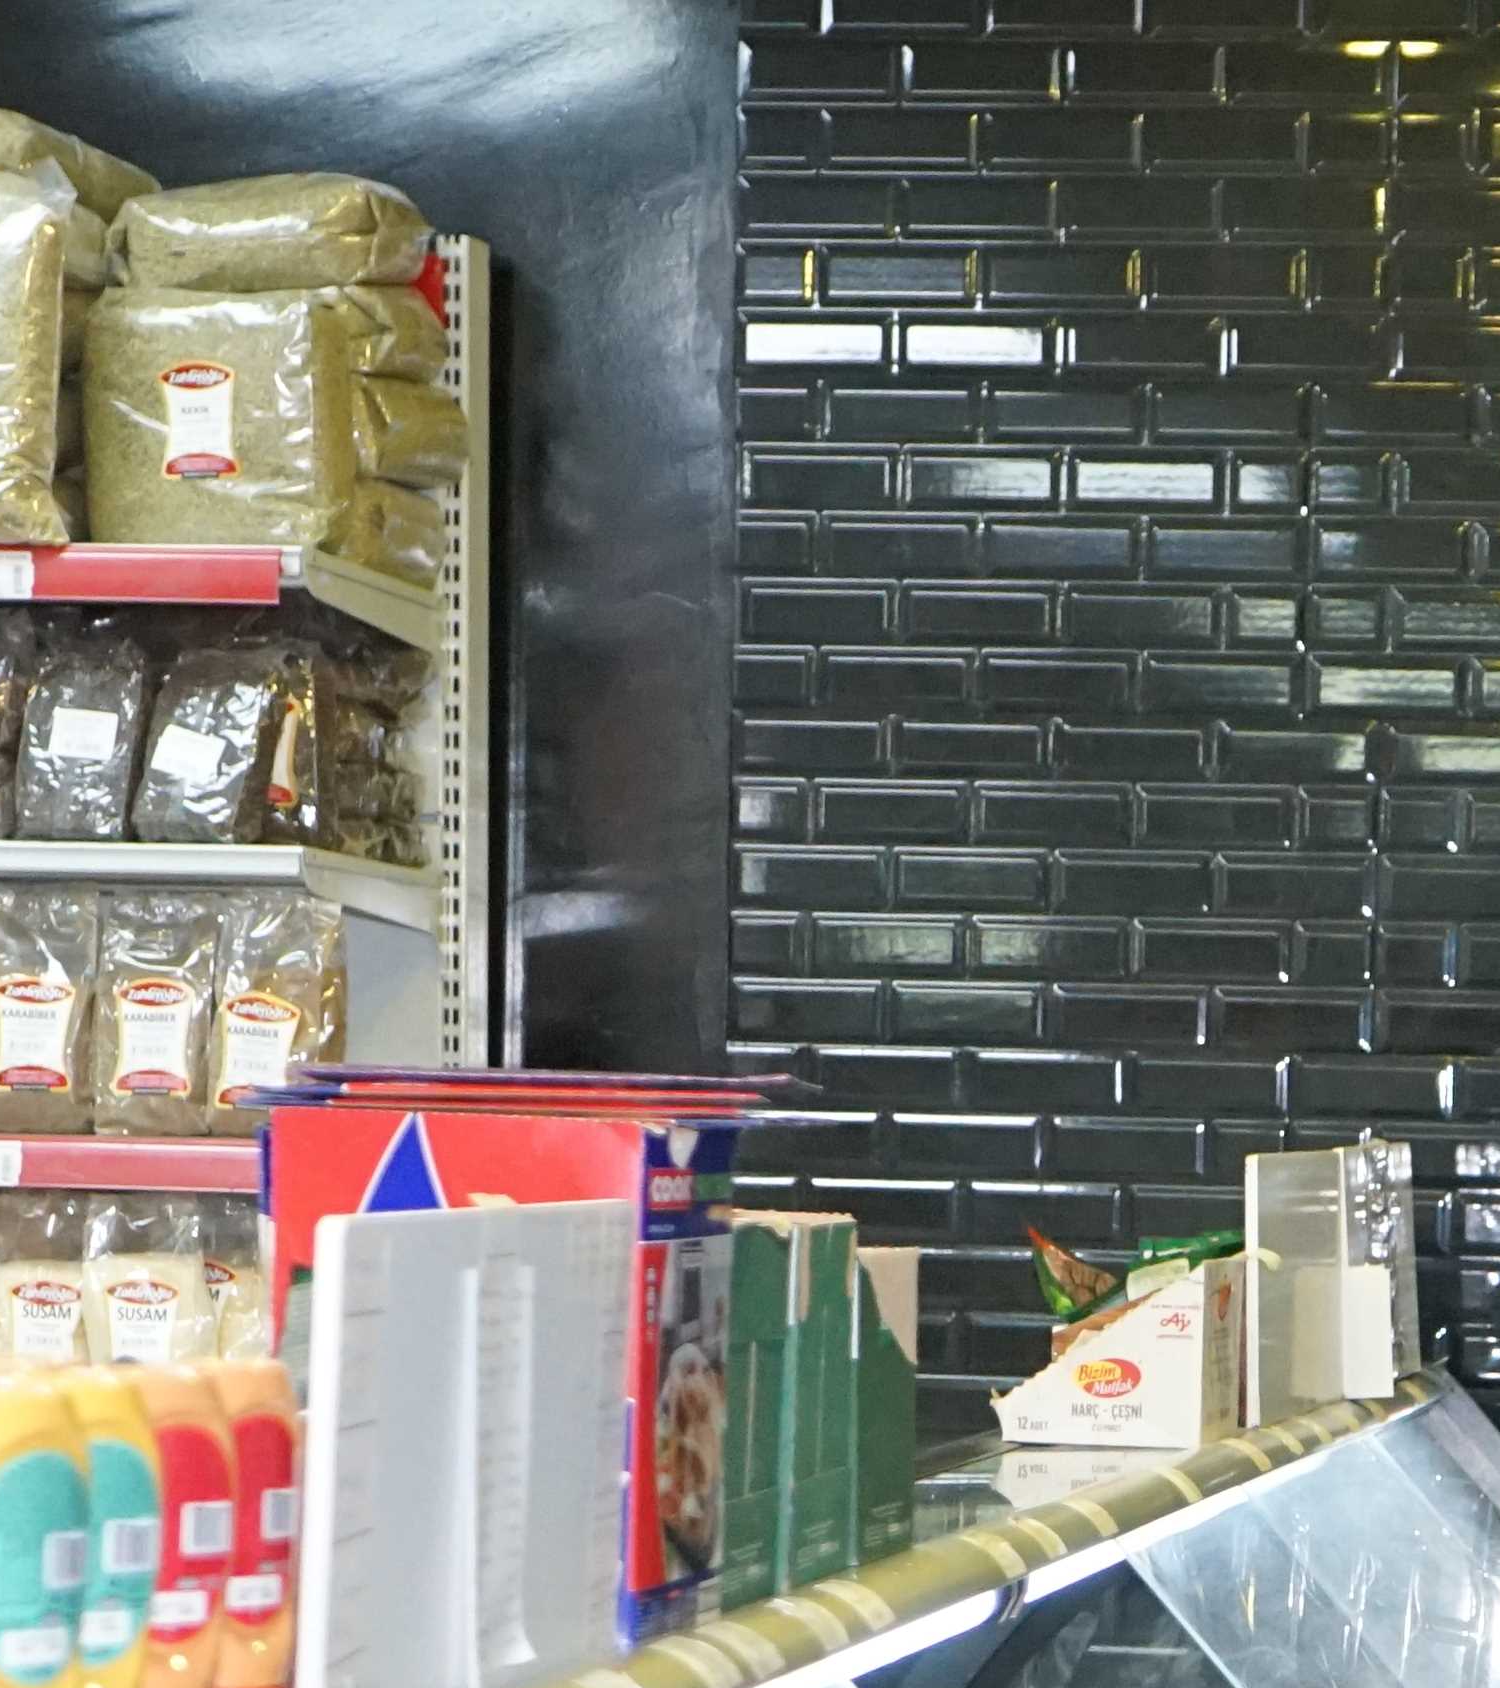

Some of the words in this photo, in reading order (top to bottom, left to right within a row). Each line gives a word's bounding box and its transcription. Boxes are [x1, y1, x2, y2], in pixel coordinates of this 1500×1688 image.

[22, 1305, 71, 1320] SUSAM
[118, 1307, 167, 1322] SUSAM
[1078, 1364, 1118, 1381] Bizim
[1091, 1380, 1133, 1394] Mutfak
[1071, 1402, 1099, 1419] HARÇ
[1017, 1416, 1028, 1430] 12
